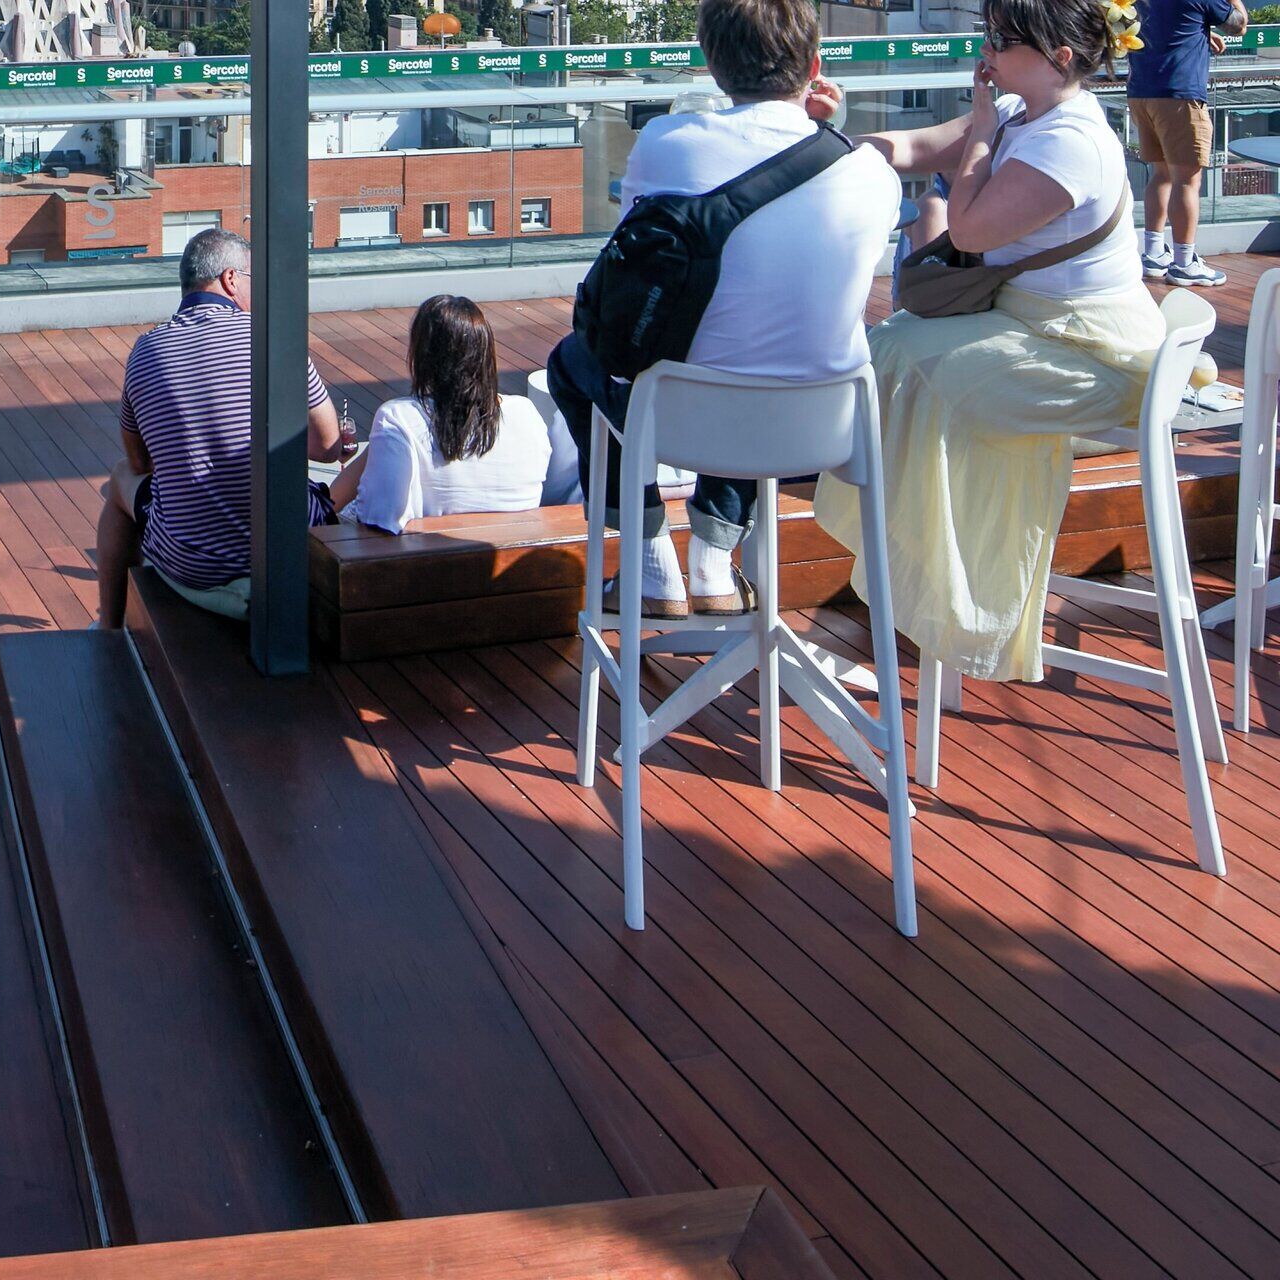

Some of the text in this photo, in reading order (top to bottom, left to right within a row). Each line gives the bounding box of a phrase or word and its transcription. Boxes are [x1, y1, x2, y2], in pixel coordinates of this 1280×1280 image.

[1258, 32, 1263, 42] S
[819, 44, 852, 56] ercotel
[888, 43, 895, 54] S
[912, 41, 949, 53] Sercotel
[966, 41, 972, 51] S
[479, 55, 520, 67] Sercotel
[539, 54, 546, 65] S
[566, 53, 606, 64] Sercotel
[625, 52, 631, 63] S
[650, 50, 690, 62] Sercotel
[309, 61, 341, 72] rcotel
[361, 60, 368, 71] S
[389, 58, 432, 70] Sercotel
[452, 57, 459, 68] S
[9, 69, 56, 82] Sercotel
[78, 68, 85, 80] S
[108, 66, 153, 79] Sercotel
[174, 65, 182, 77] S
[203, 63, 248, 76] Sercotel
[85, 184, 116, 227] S
